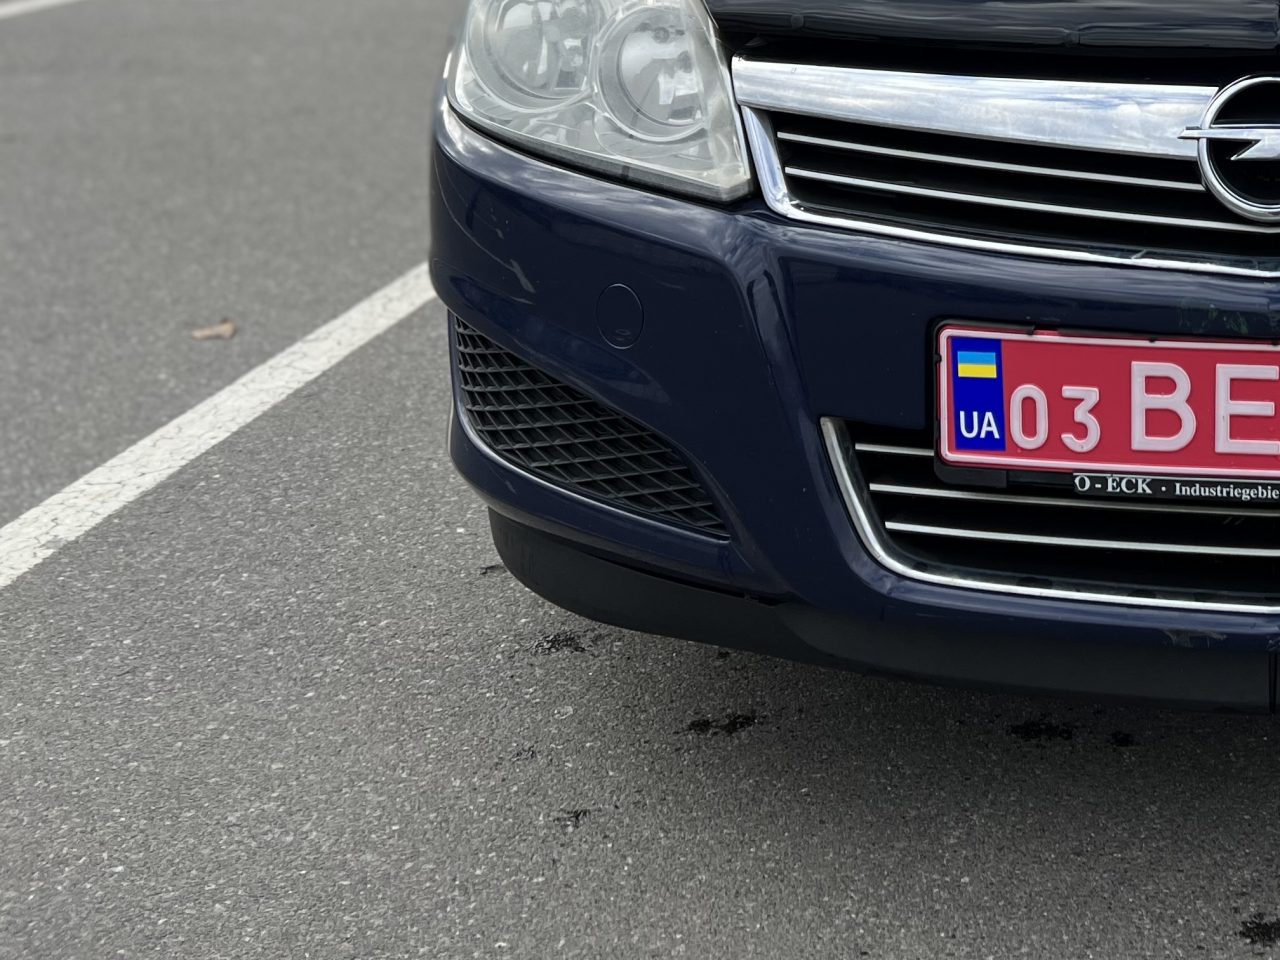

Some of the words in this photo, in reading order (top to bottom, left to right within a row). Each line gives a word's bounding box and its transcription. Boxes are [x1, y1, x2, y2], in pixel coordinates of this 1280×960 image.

[959, 410, 1000, 439] UA
[1009, 384, 1101, 453] 03
[1130, 361, 1280, 456] BE
